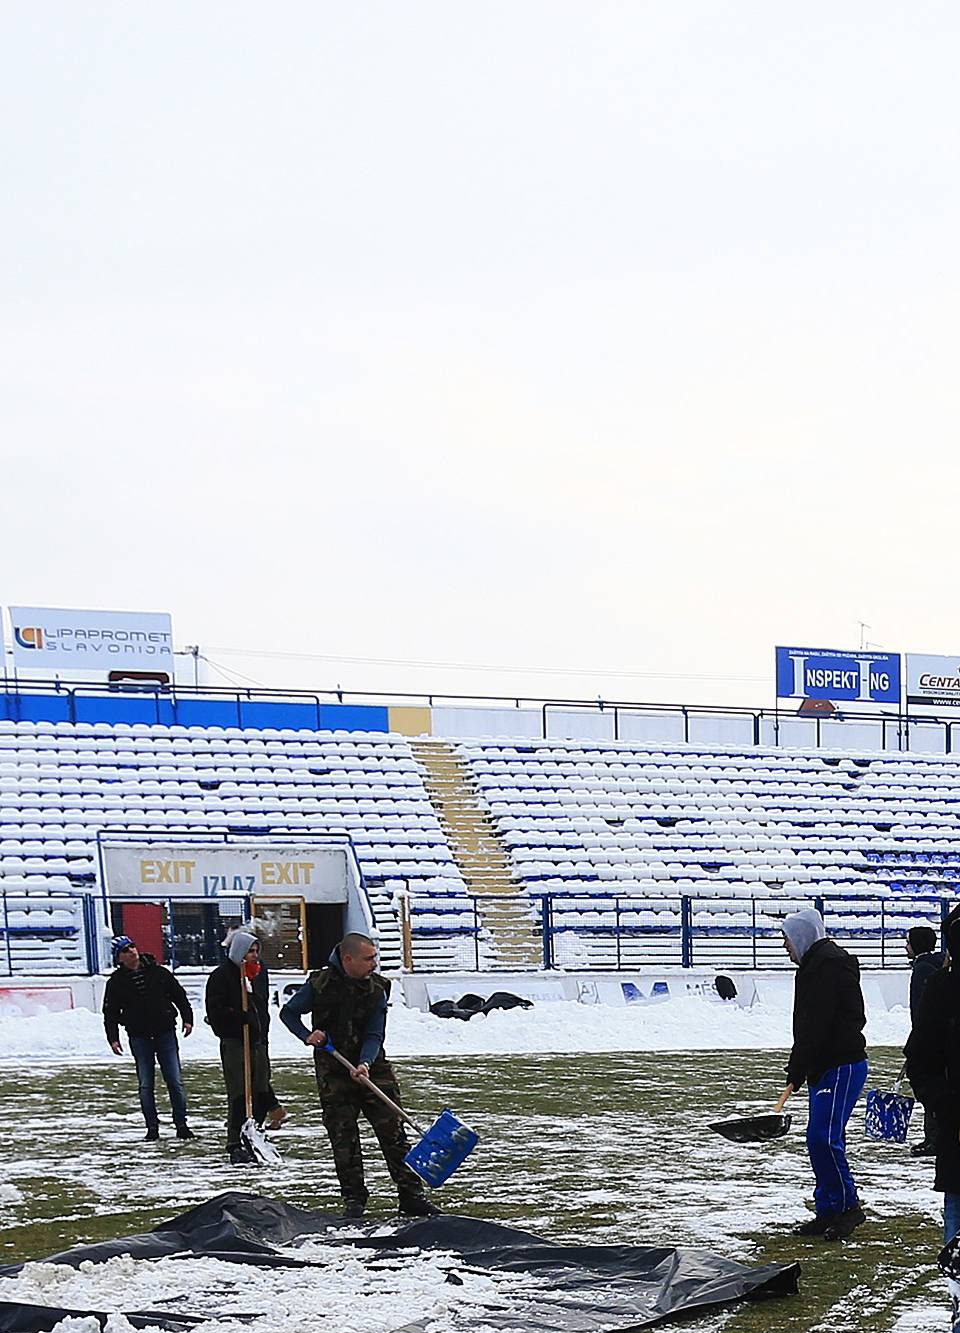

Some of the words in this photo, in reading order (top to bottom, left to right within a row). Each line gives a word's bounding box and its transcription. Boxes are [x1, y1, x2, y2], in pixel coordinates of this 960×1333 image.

[44, 627, 171, 643] LIPAPROMET
[46, 641, 171, 655] SLAVONIJA
[140, 860, 196, 884] EXIT
[261, 862, 315, 885] EXIT
